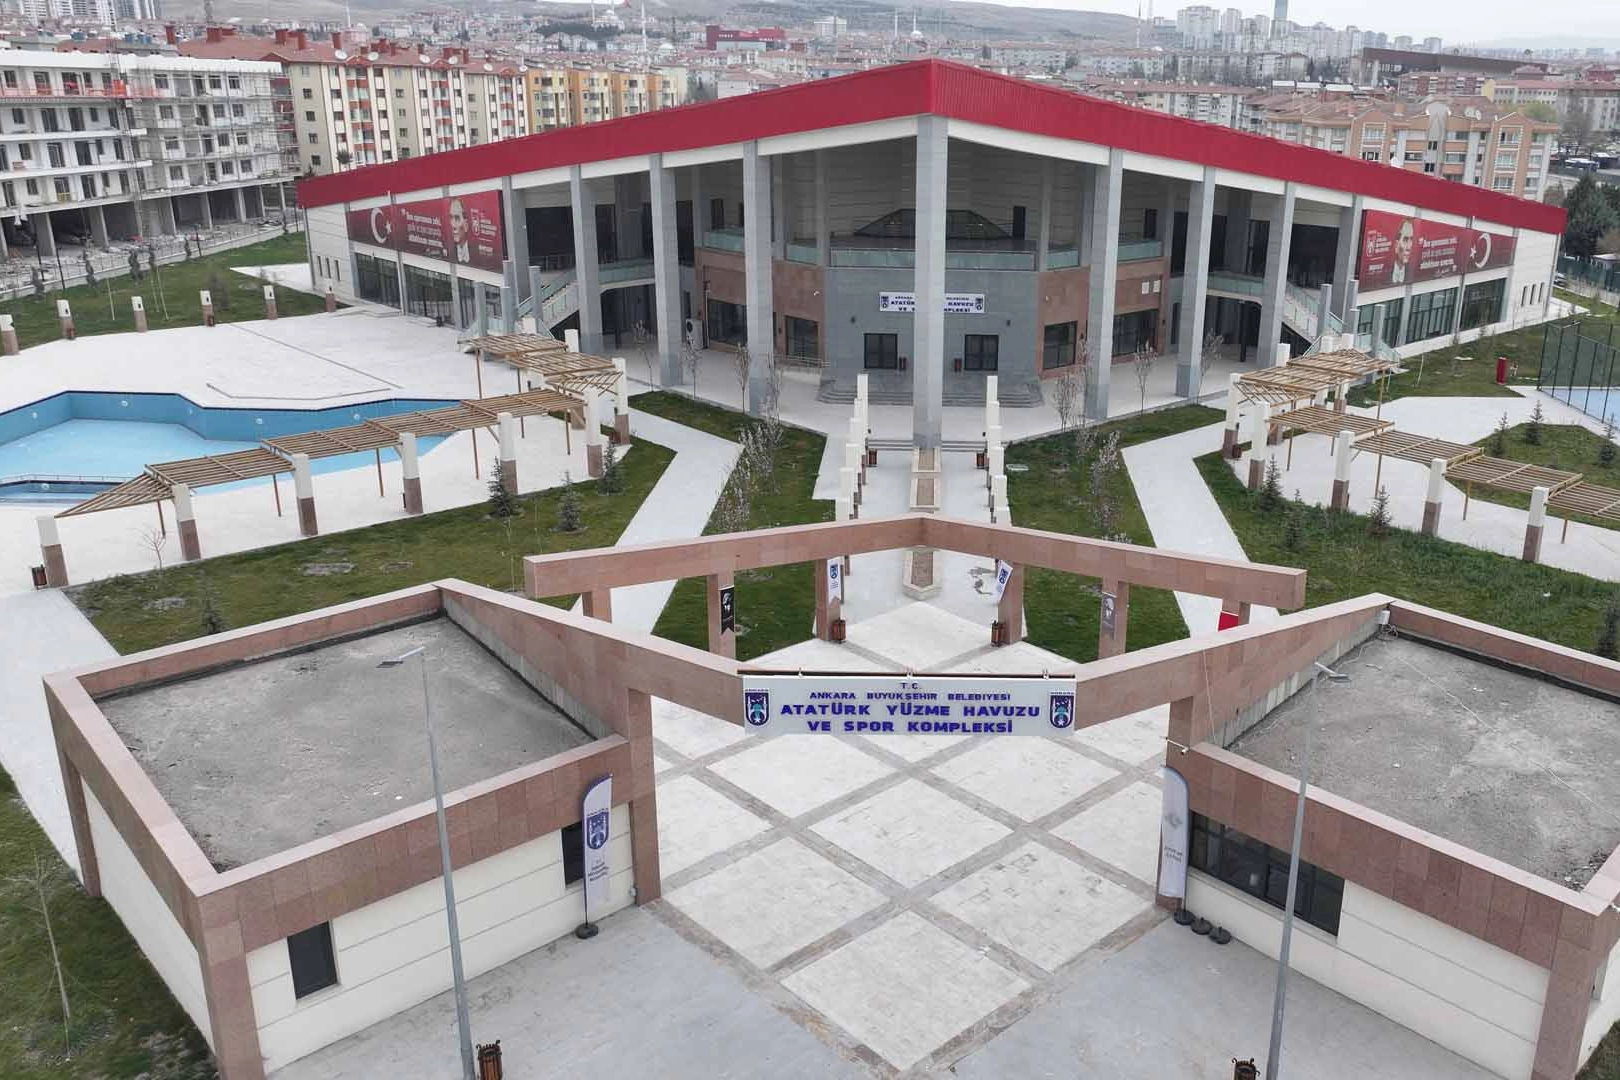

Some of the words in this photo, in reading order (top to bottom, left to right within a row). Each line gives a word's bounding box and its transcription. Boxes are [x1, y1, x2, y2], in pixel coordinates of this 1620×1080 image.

[901, 682, 922, 691] T.C.
[809, 692, 856, 700] ANKARA
[780, 702, 871, 716] ATATÜRK
[886, 702, 951, 717] YÜZME
[963, 706, 1040, 717] HAVUZU
[807, 721, 831, 732] VE
[844, 721, 895, 733] SPOR
[907, 720, 1013, 733] KOMPLEKSİ
